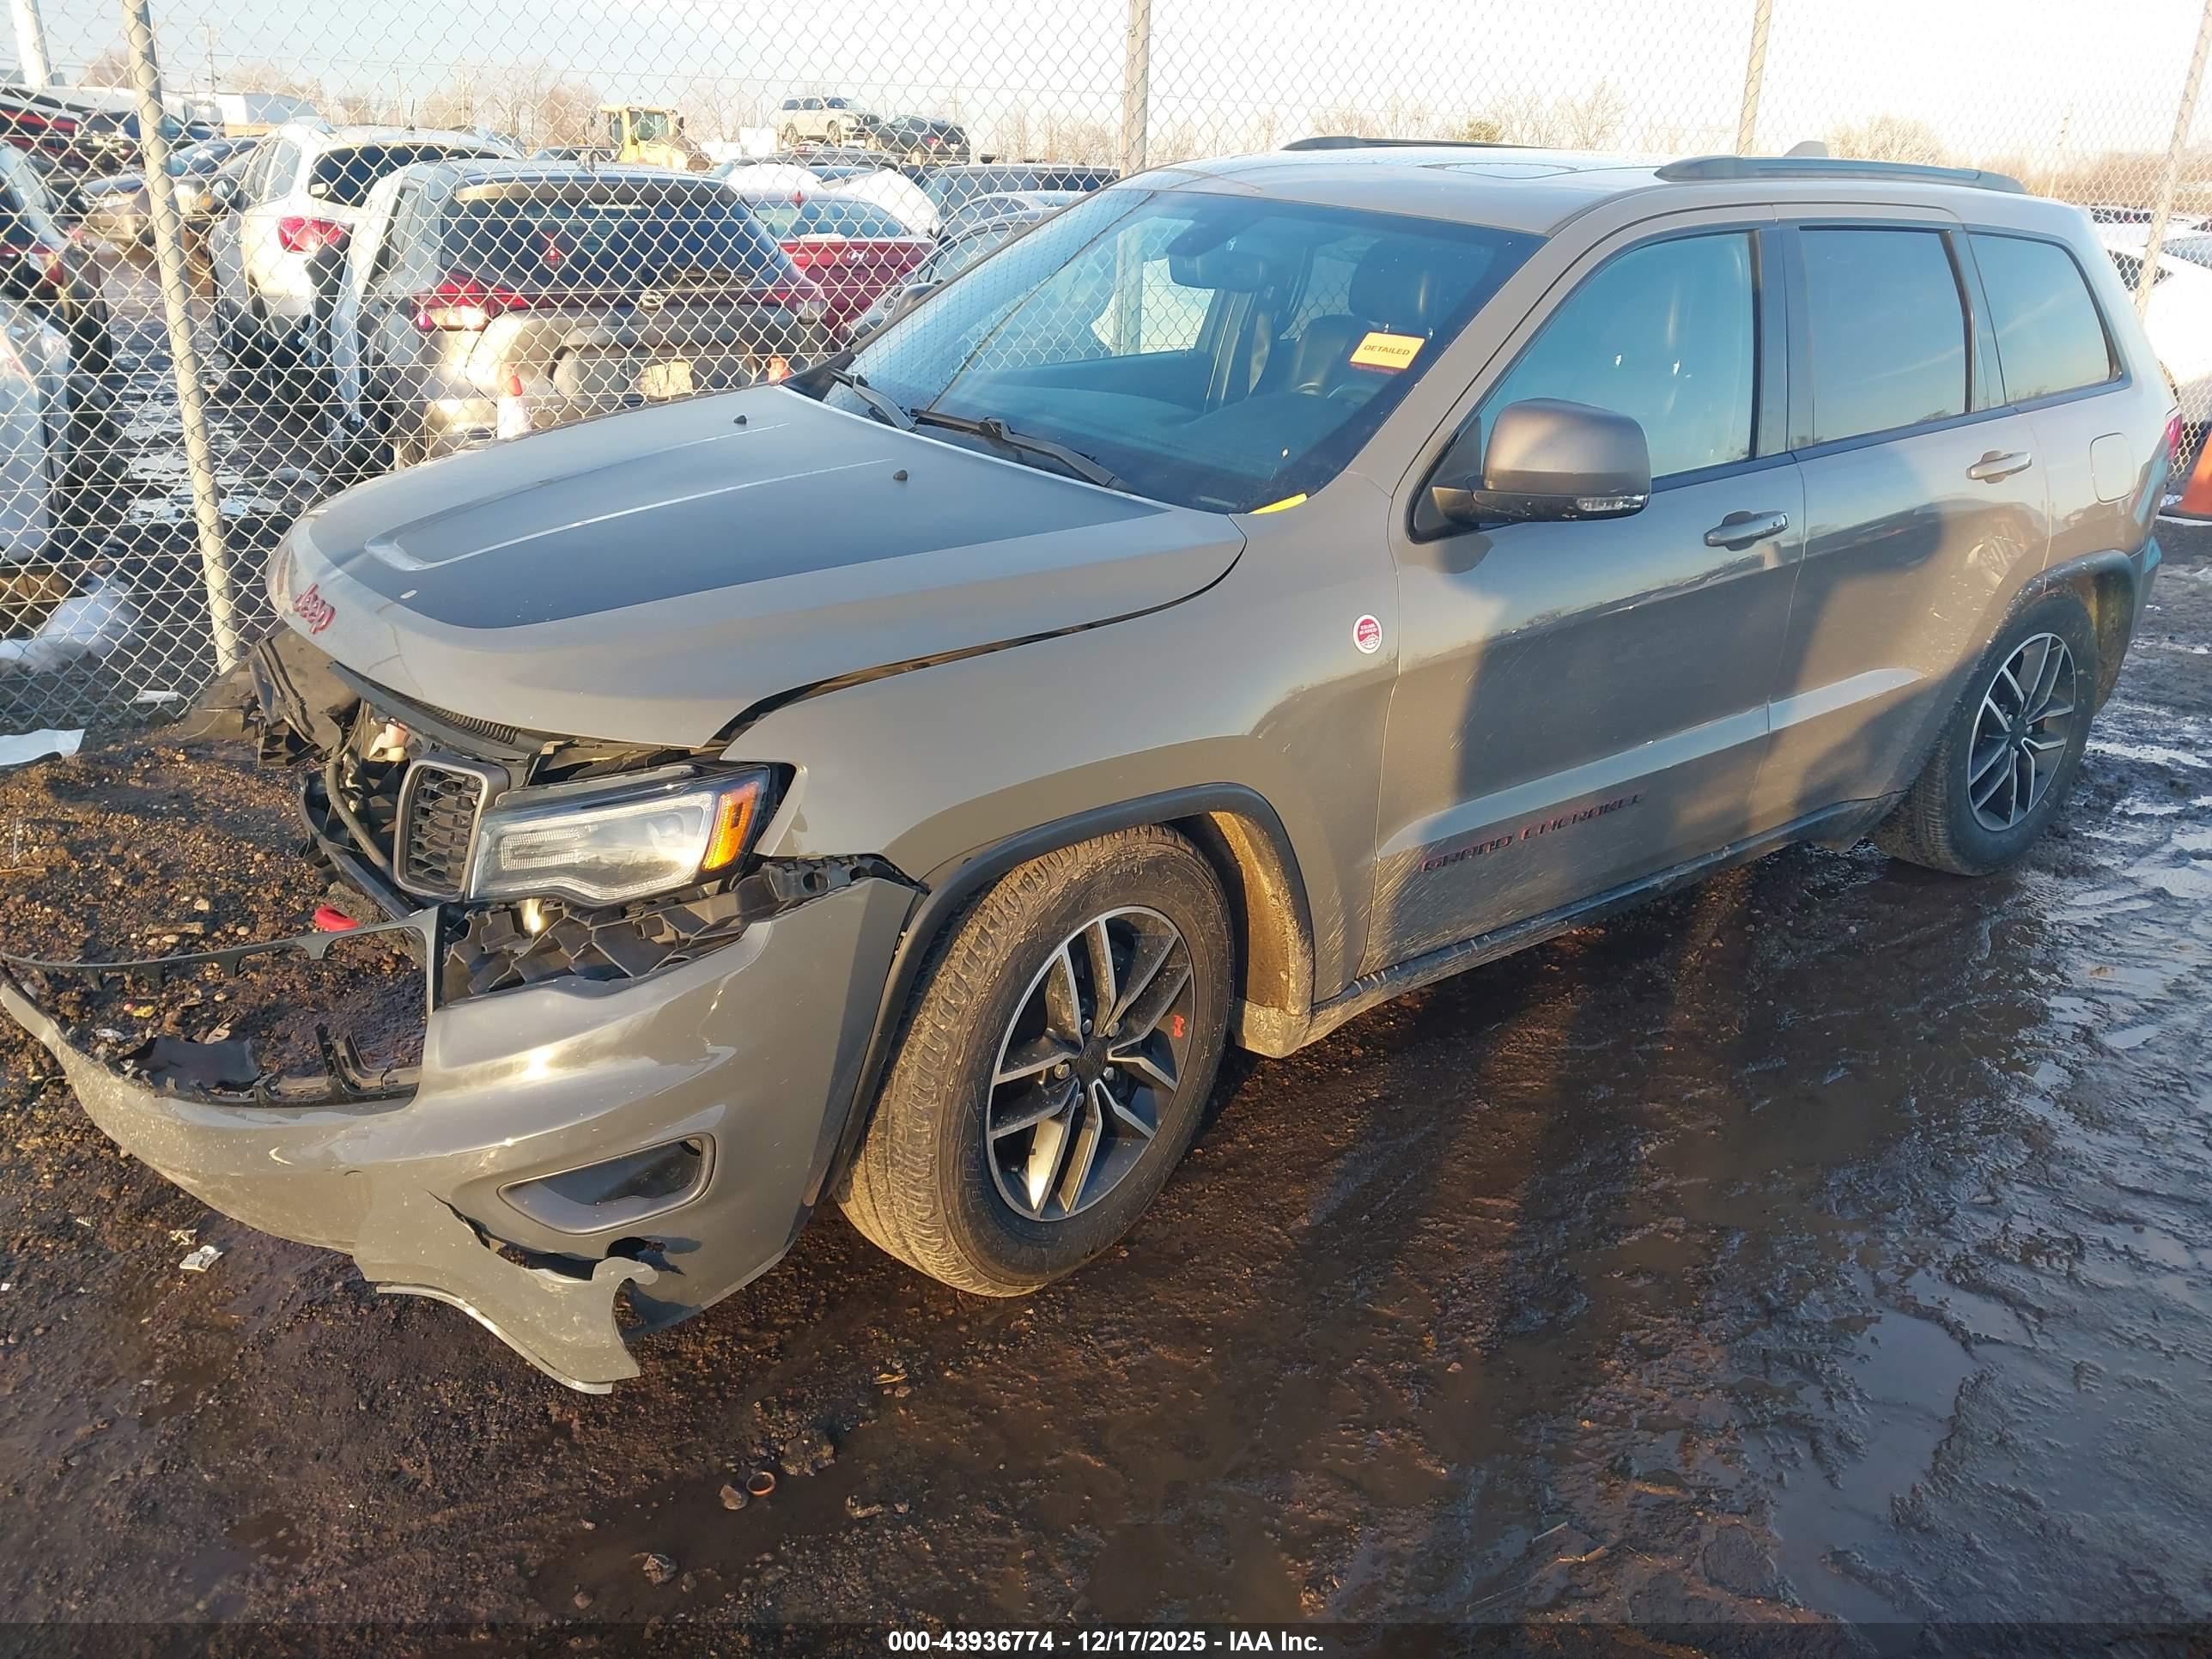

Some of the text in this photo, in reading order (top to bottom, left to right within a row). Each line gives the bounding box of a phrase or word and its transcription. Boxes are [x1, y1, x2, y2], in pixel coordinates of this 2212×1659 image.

[1364, 344, 1411, 356] DETAILED
[294, 583, 336, 635] Jeep
[1419, 833, 1514, 872] GRAND
